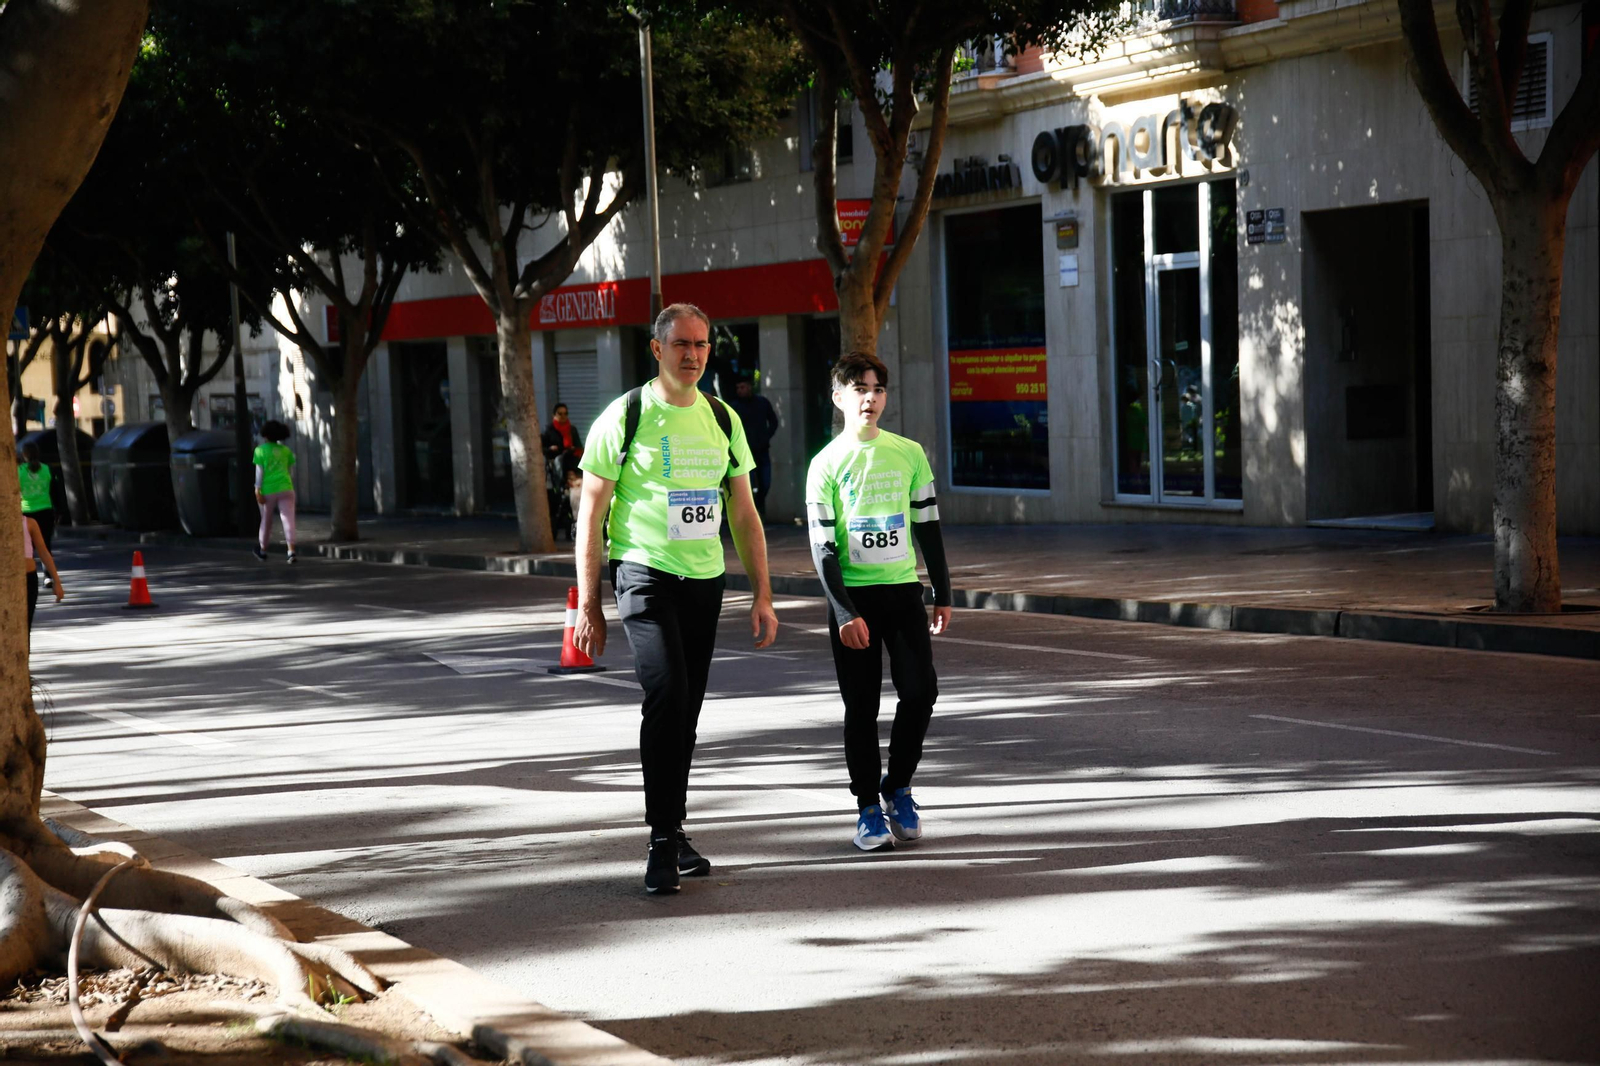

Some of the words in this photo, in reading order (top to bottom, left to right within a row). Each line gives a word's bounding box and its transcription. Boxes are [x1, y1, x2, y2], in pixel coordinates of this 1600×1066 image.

[556, 288, 616, 322] GENERALI
[1016, 364, 1037, 374] personal
[1016, 383, 1029, 394] 950
[1030, 383, 1039, 394] 25
[659, 435, 671, 478] ALMERÍA
[672, 447, 685, 456] En
[686, 447, 721, 456] marcha
[673, 456, 709, 466] contra
[712, 456, 722, 466] el
[673, 467, 721, 479] cáncer
[868, 469, 902, 481] marcha
[893, 478, 902, 488] el
[860, 491, 903, 506] cáncer
[681, 505, 715, 524] 684
[861, 530, 899, 549] 685
